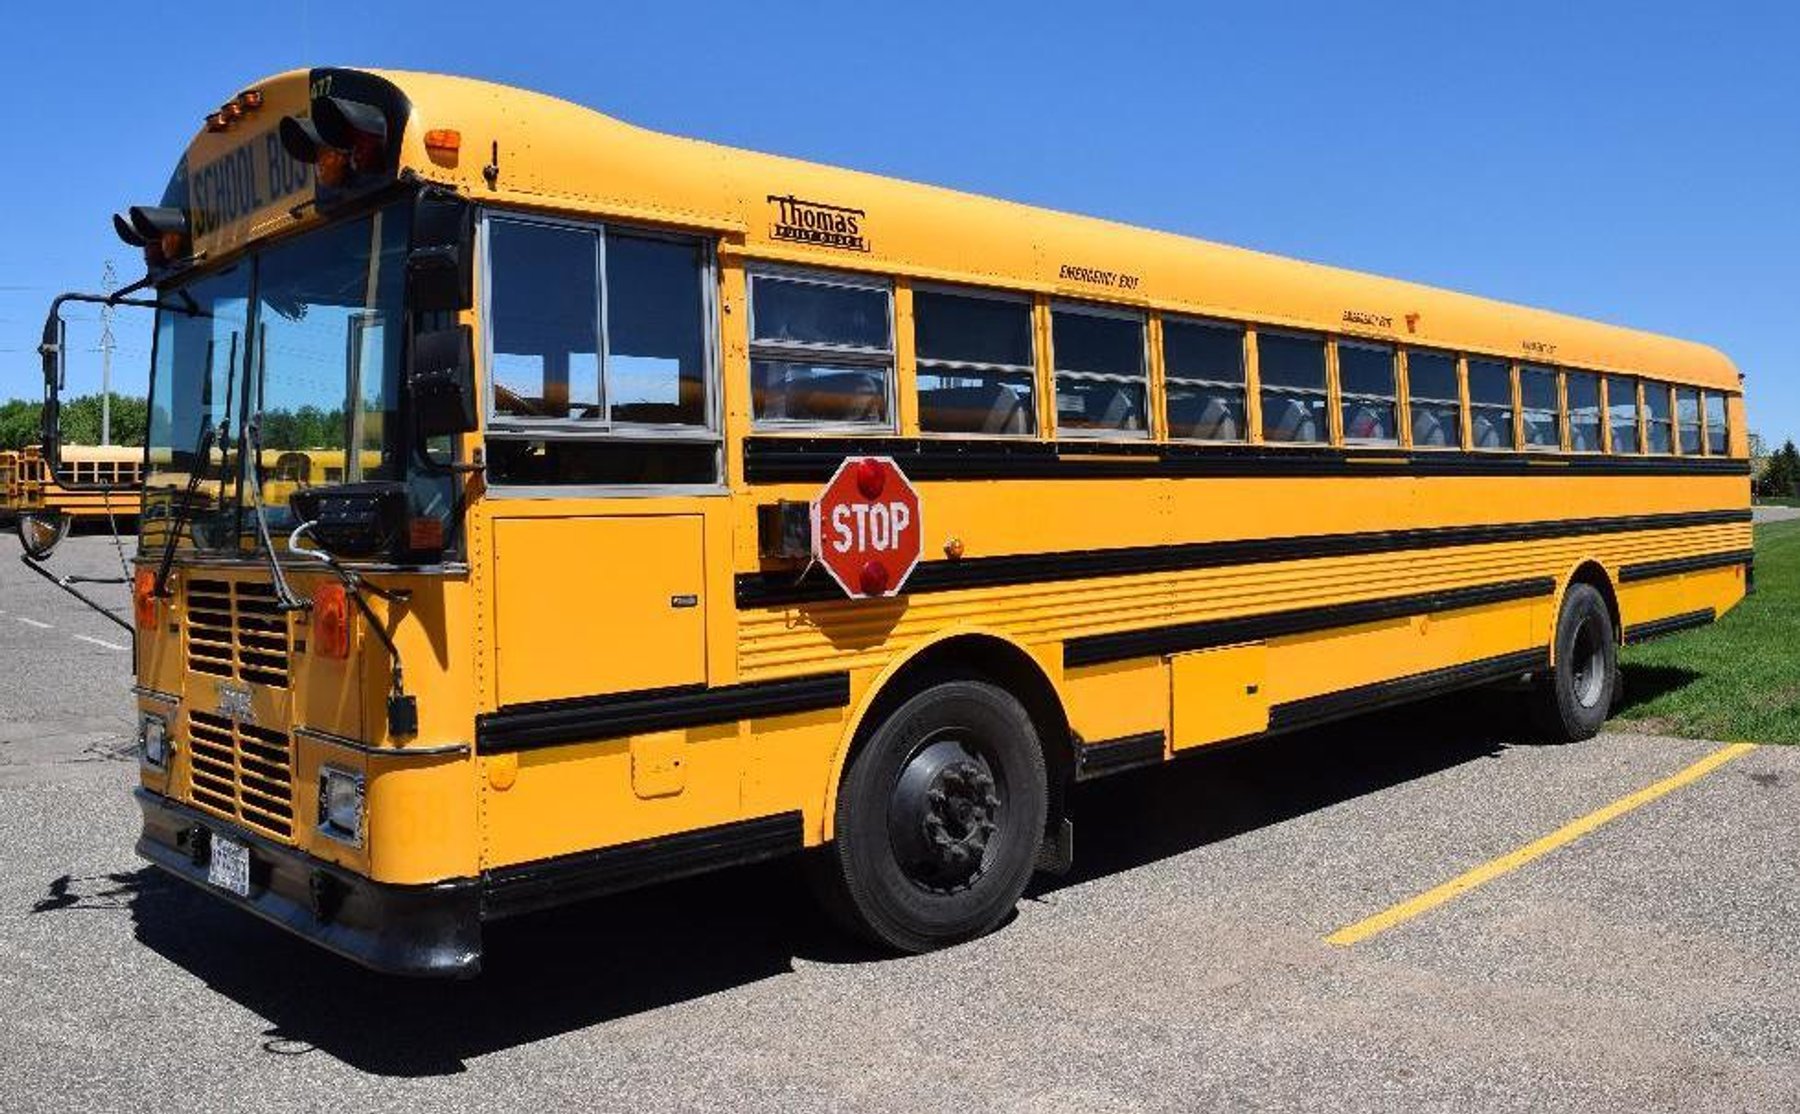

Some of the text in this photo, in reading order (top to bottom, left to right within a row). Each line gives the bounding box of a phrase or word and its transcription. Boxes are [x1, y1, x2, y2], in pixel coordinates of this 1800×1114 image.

[193, 141, 263, 238] SCHOOL
[767, 194, 865, 234] Thomas
[1118, 274, 1139, 289] EXIT
[832, 502, 910, 552] STOP
